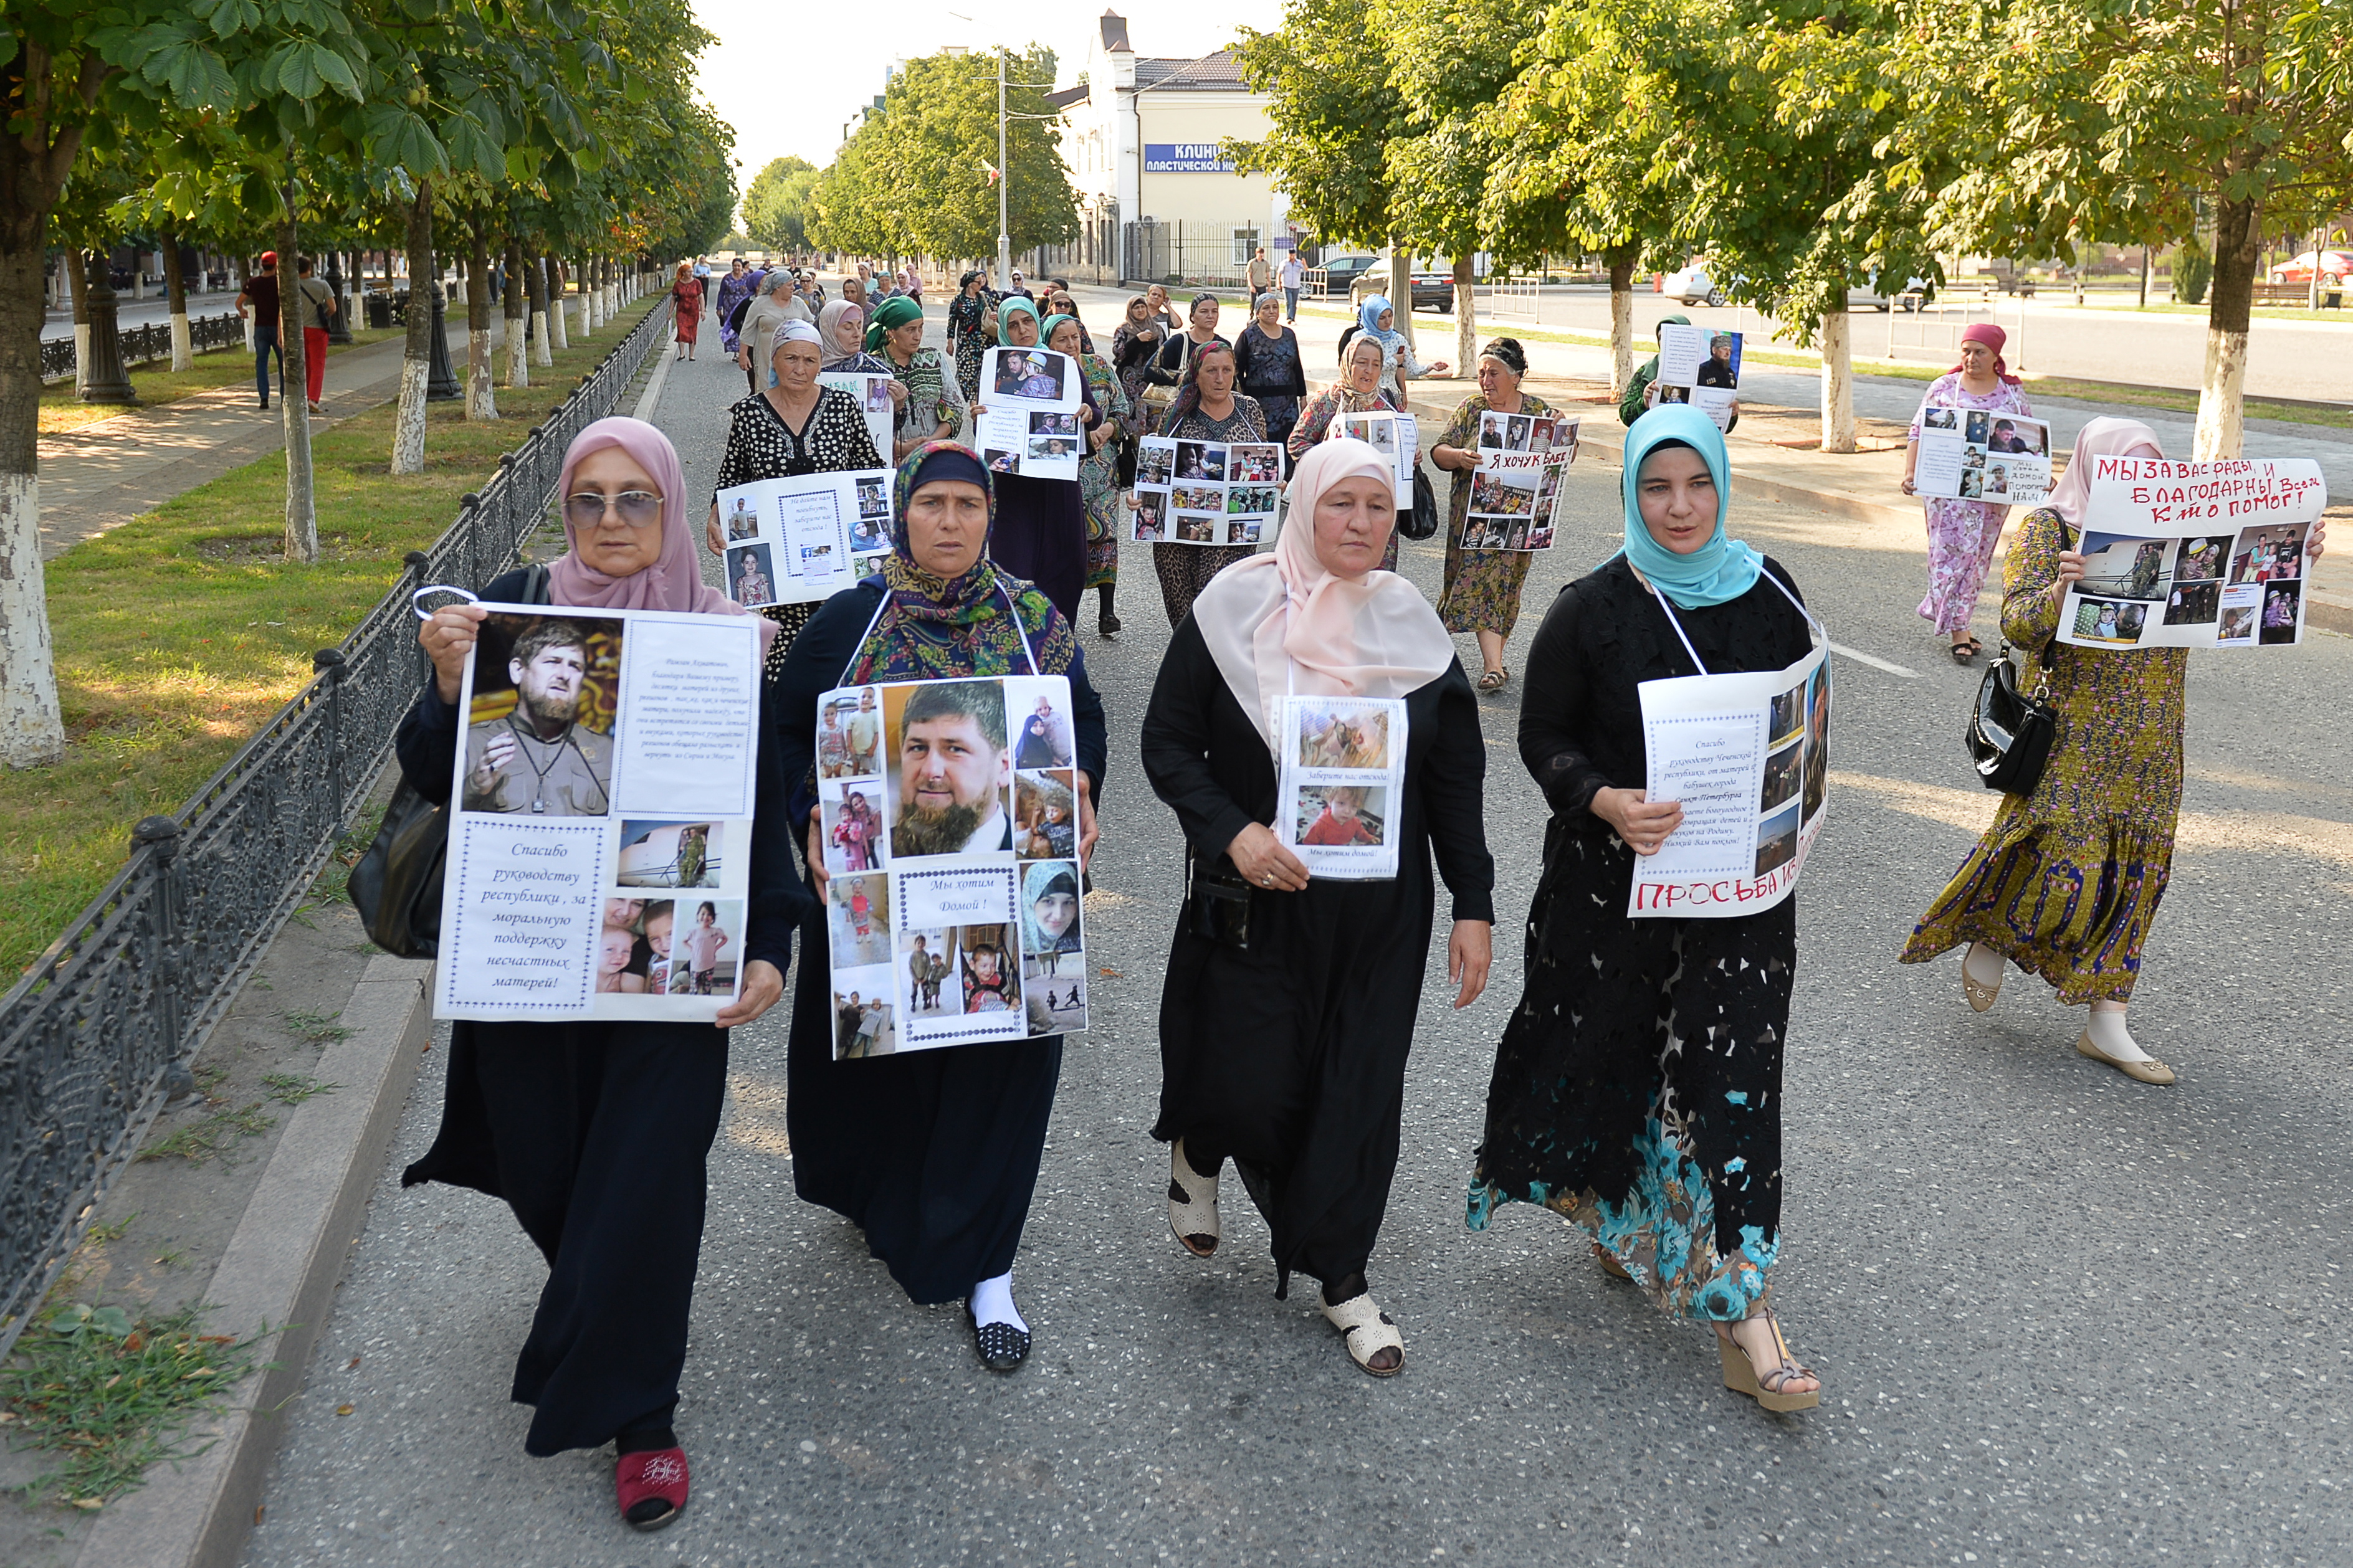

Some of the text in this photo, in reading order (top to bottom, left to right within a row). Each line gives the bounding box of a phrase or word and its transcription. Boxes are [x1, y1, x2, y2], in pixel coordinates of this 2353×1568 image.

[1147, 160, 1220, 171] ПЛАСТИЧЕСКОЙ
[1489, 454, 1501, 469] Я
[2098, 459, 2138, 481] МЫ
[2144, 461, 2171, 479] ЗА
[2176, 463, 2208, 478] ВАС
[2263, 463, 2275, 479] И
[2131, 478, 2271, 503] БЛАГОДАРНЫ
[1696, 738, 1725, 749] Спасибо
[1669, 751, 1751, 767] руководству Чеченской
[1307, 771, 1343, 781] Заберите
[1664, 769, 1705, 781] республики,
[1719, 764, 1749, 774] матерей
[1683, 778, 1737, 791] бабушек города
[1675, 792, 1742, 804] Санкт-Петербурга
[1706, 805, 1747, 815] богоугодное
[1682, 819, 1716, 827] озвращая
[1707, 827, 1734, 837] Родину.
[1663, 839, 1692, 848] Низкий
[1712, 837, 1740, 845] поклон!
[512, 843, 568, 857] Спасибо
[492, 868, 580, 886] руководству
[1638, 857, 1796, 910] ПРОСЬБА ИЗ
[930, 880, 995, 891] Мы хотим
[571, 896, 587, 905] за
[939, 900, 979, 911] Домой
[492, 914, 571, 929] моральную
[494, 931, 567, 950] поддержку
[487, 957, 571, 971] несчастных
[492, 977, 558, 991] матерей!
